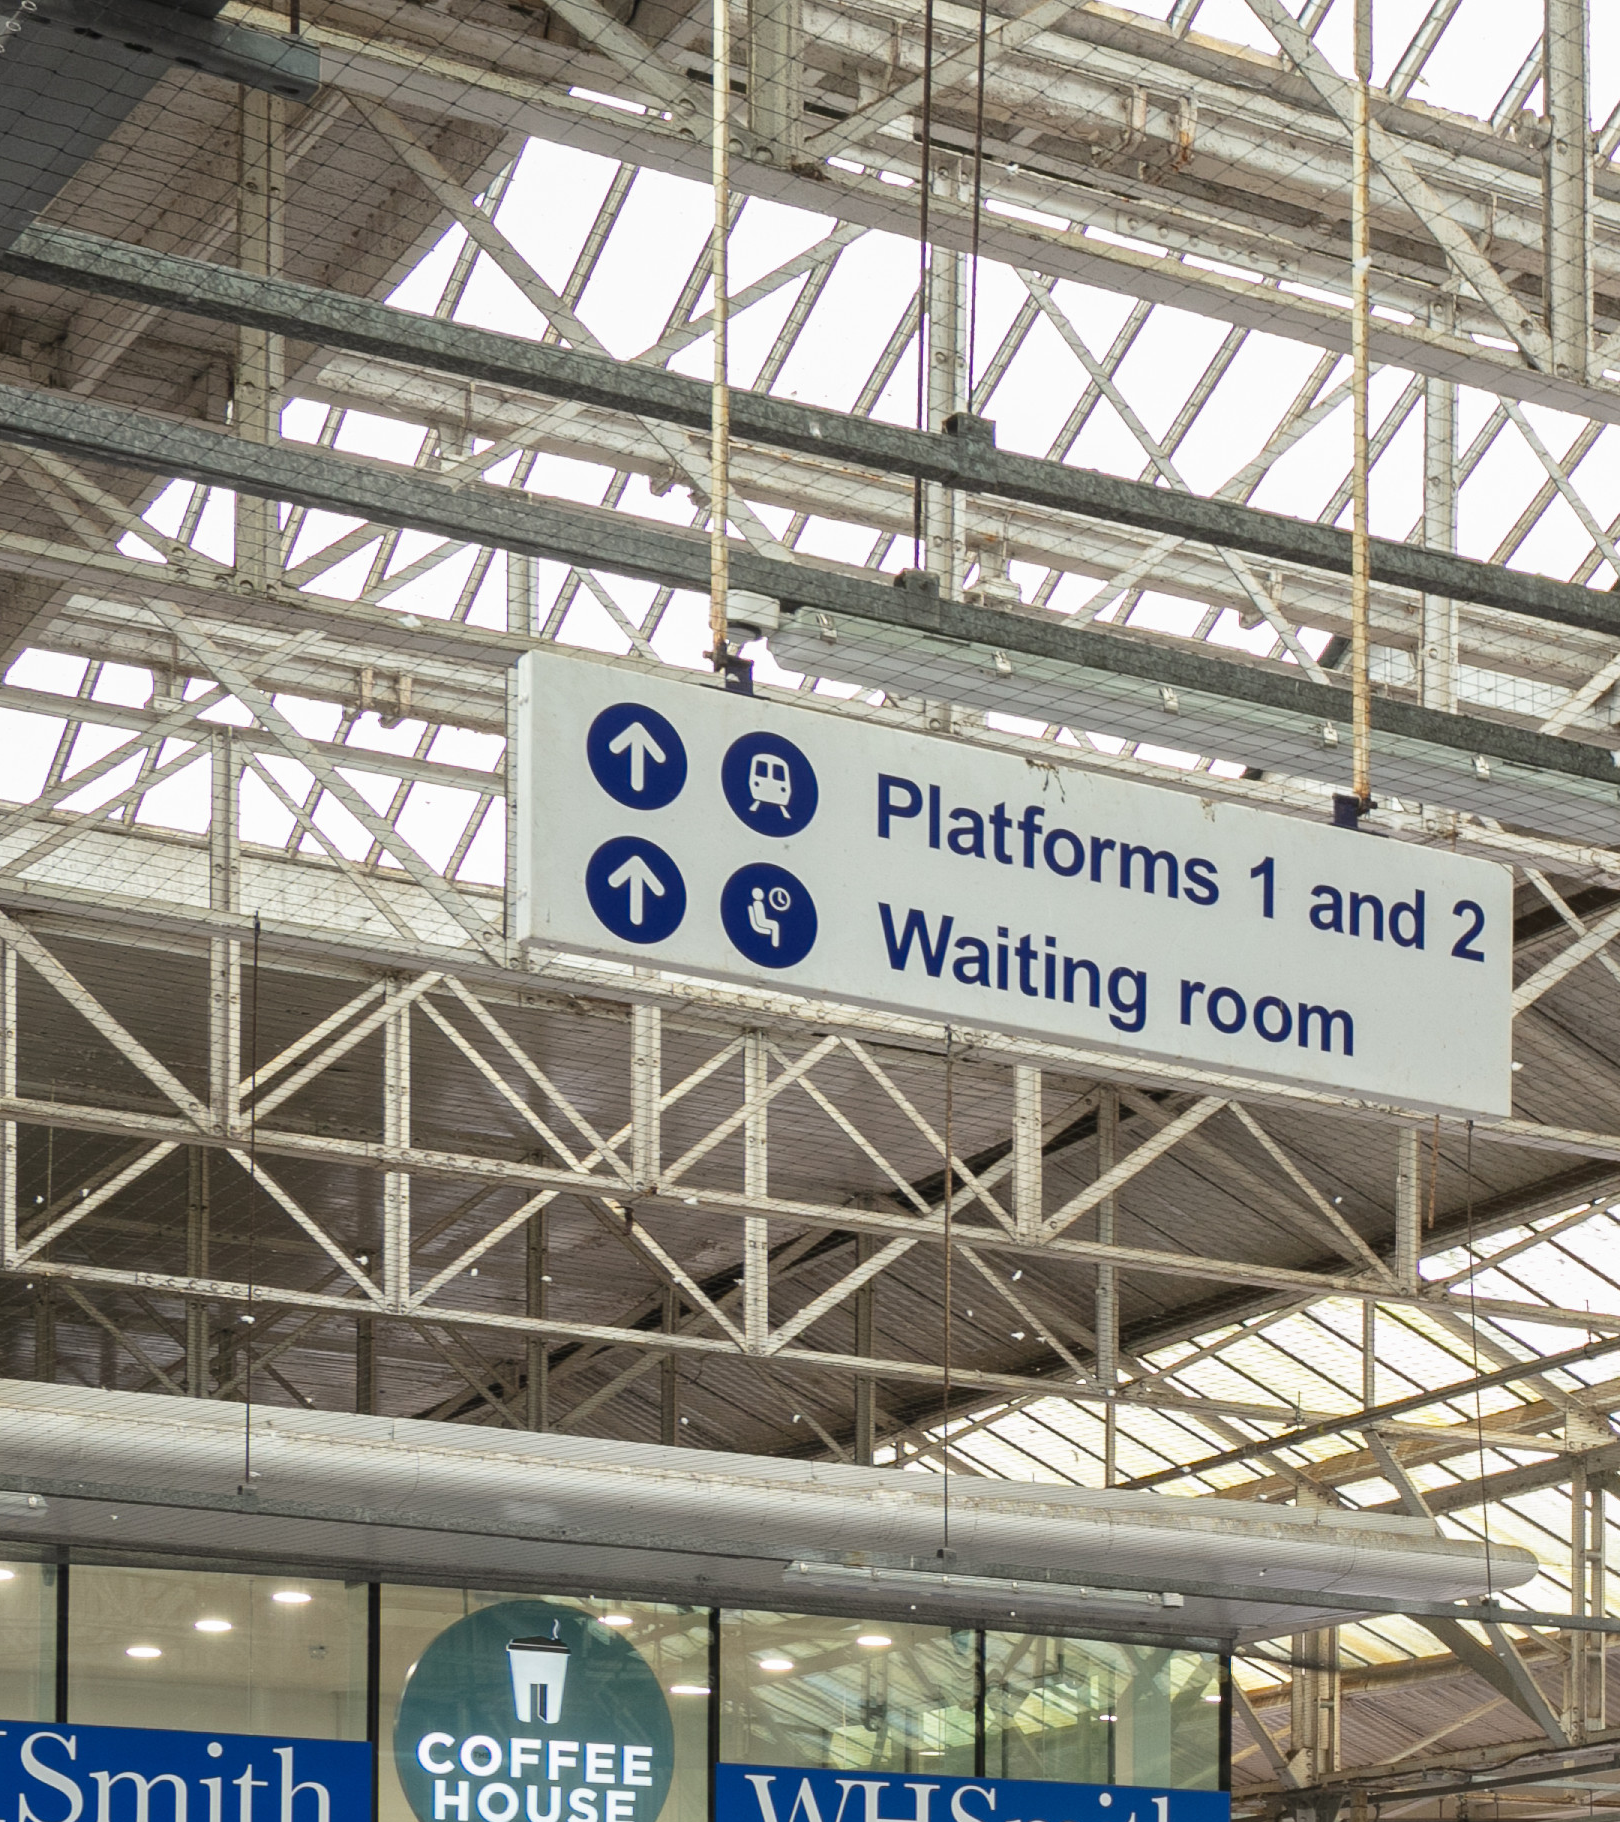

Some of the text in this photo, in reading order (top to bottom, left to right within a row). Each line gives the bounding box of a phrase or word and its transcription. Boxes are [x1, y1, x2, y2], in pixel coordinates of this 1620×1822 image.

[877, 772, 1486, 962] Platforms 1 and 2
[878, 902, 1355, 1056] Waiting room
[416, 1730, 654, 1788] COFFEE
